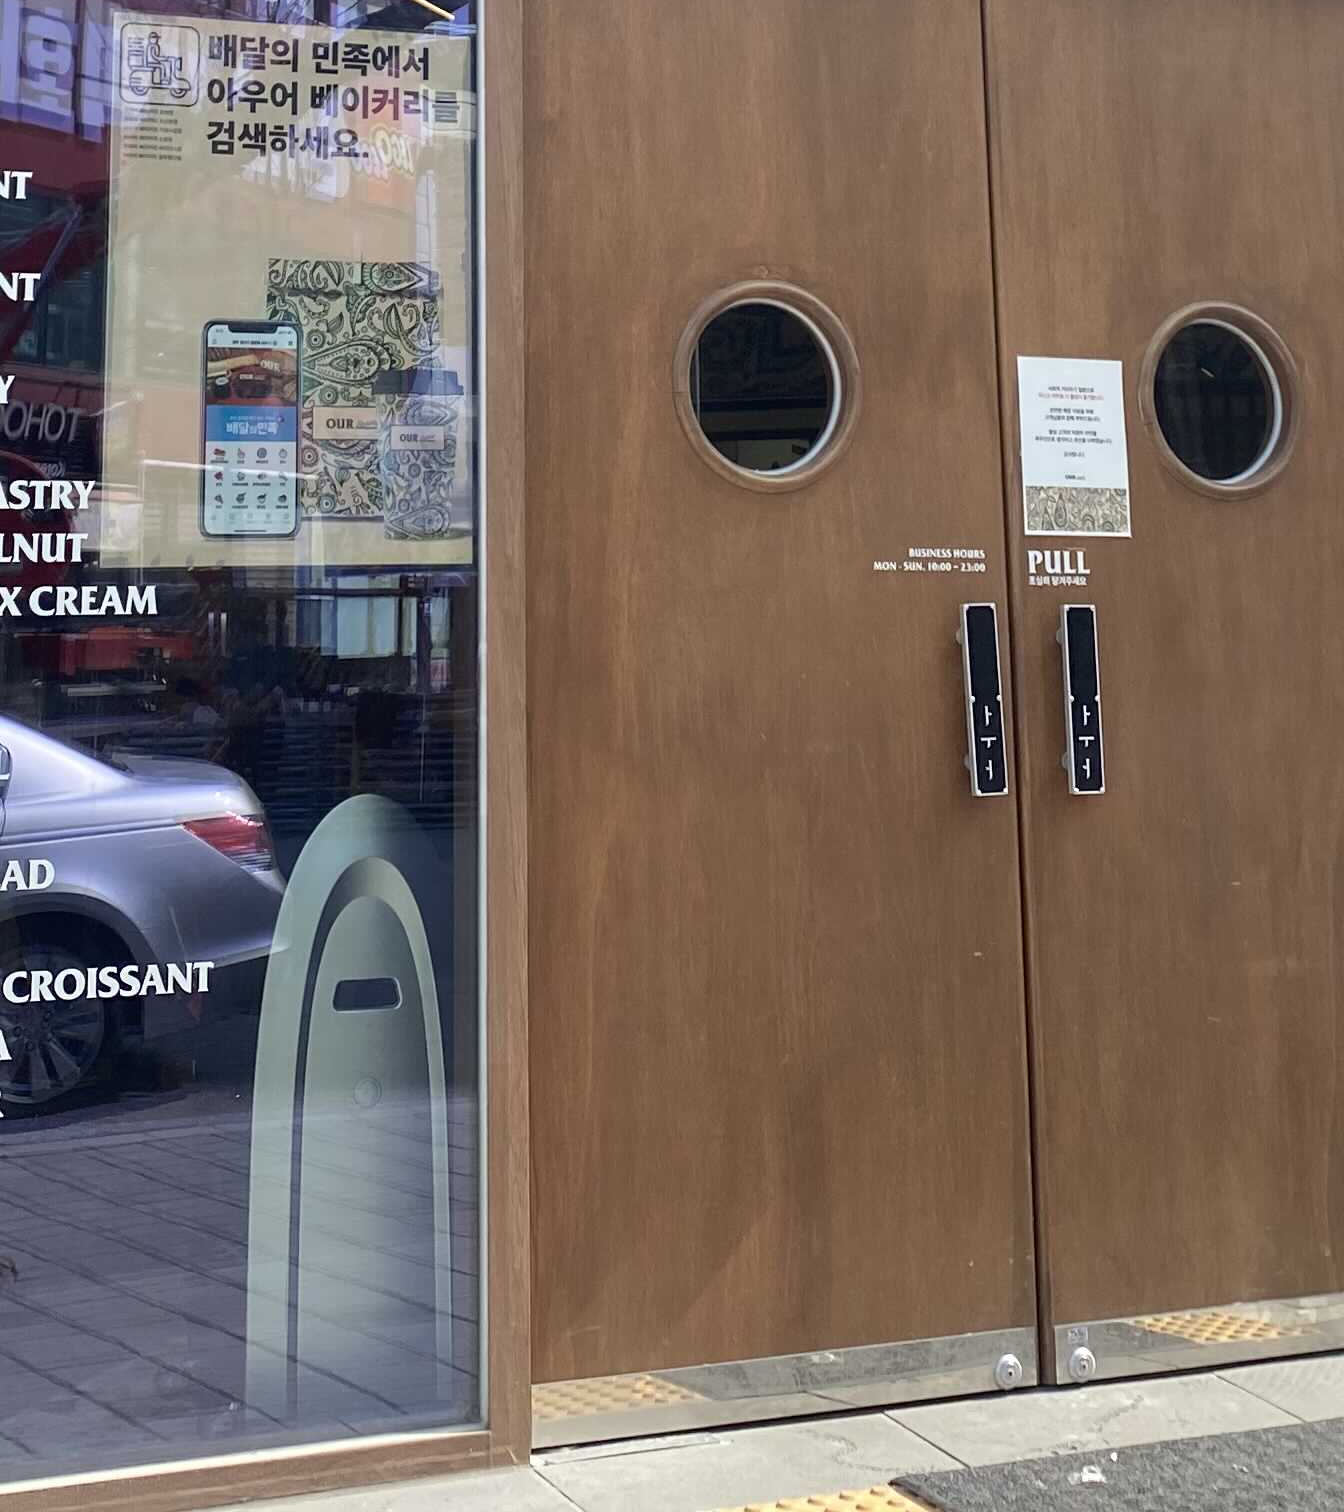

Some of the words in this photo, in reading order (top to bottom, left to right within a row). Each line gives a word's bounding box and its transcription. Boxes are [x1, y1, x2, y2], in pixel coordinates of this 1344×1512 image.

[208, 33, 299, 73] 배달의
[312, 38, 430, 80] 민족에서
[207, 80, 299, 117] 아우어
[310, 84, 460, 125] 베이커리를
[208, 120, 370, 161] 검색하세요.
[909, 548, 952, 558] BUSINESS
[953, 549, 986, 559] HOURS
[1027, 550, 1090, 575] PULL
[30, 586, 157, 616] CREAM
[3, 962, 214, 1003] CROISSANT
